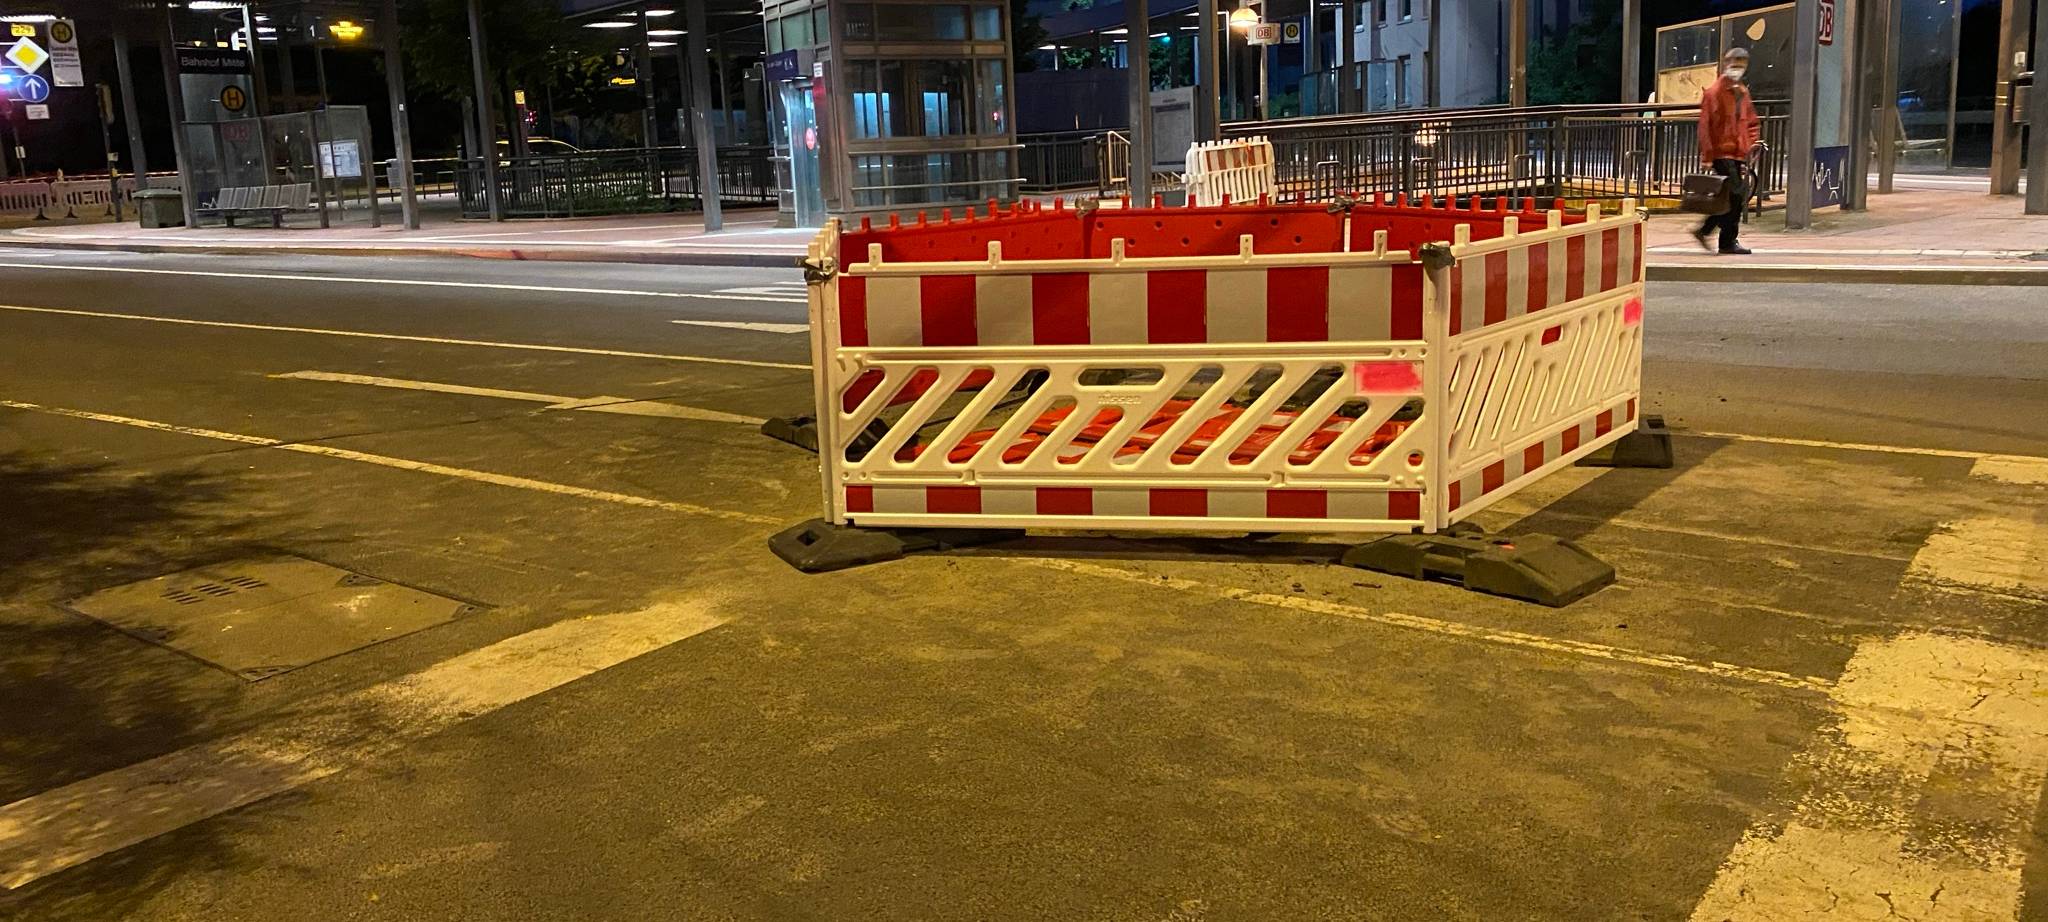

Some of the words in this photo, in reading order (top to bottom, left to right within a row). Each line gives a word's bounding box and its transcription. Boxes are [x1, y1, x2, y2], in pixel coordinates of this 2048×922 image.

[1257, 28, 1270, 37] DB
[181, 56, 220, 67] Bahnhof
[222, 57, 246, 68] Mitte
[227, 90, 240, 107] H
